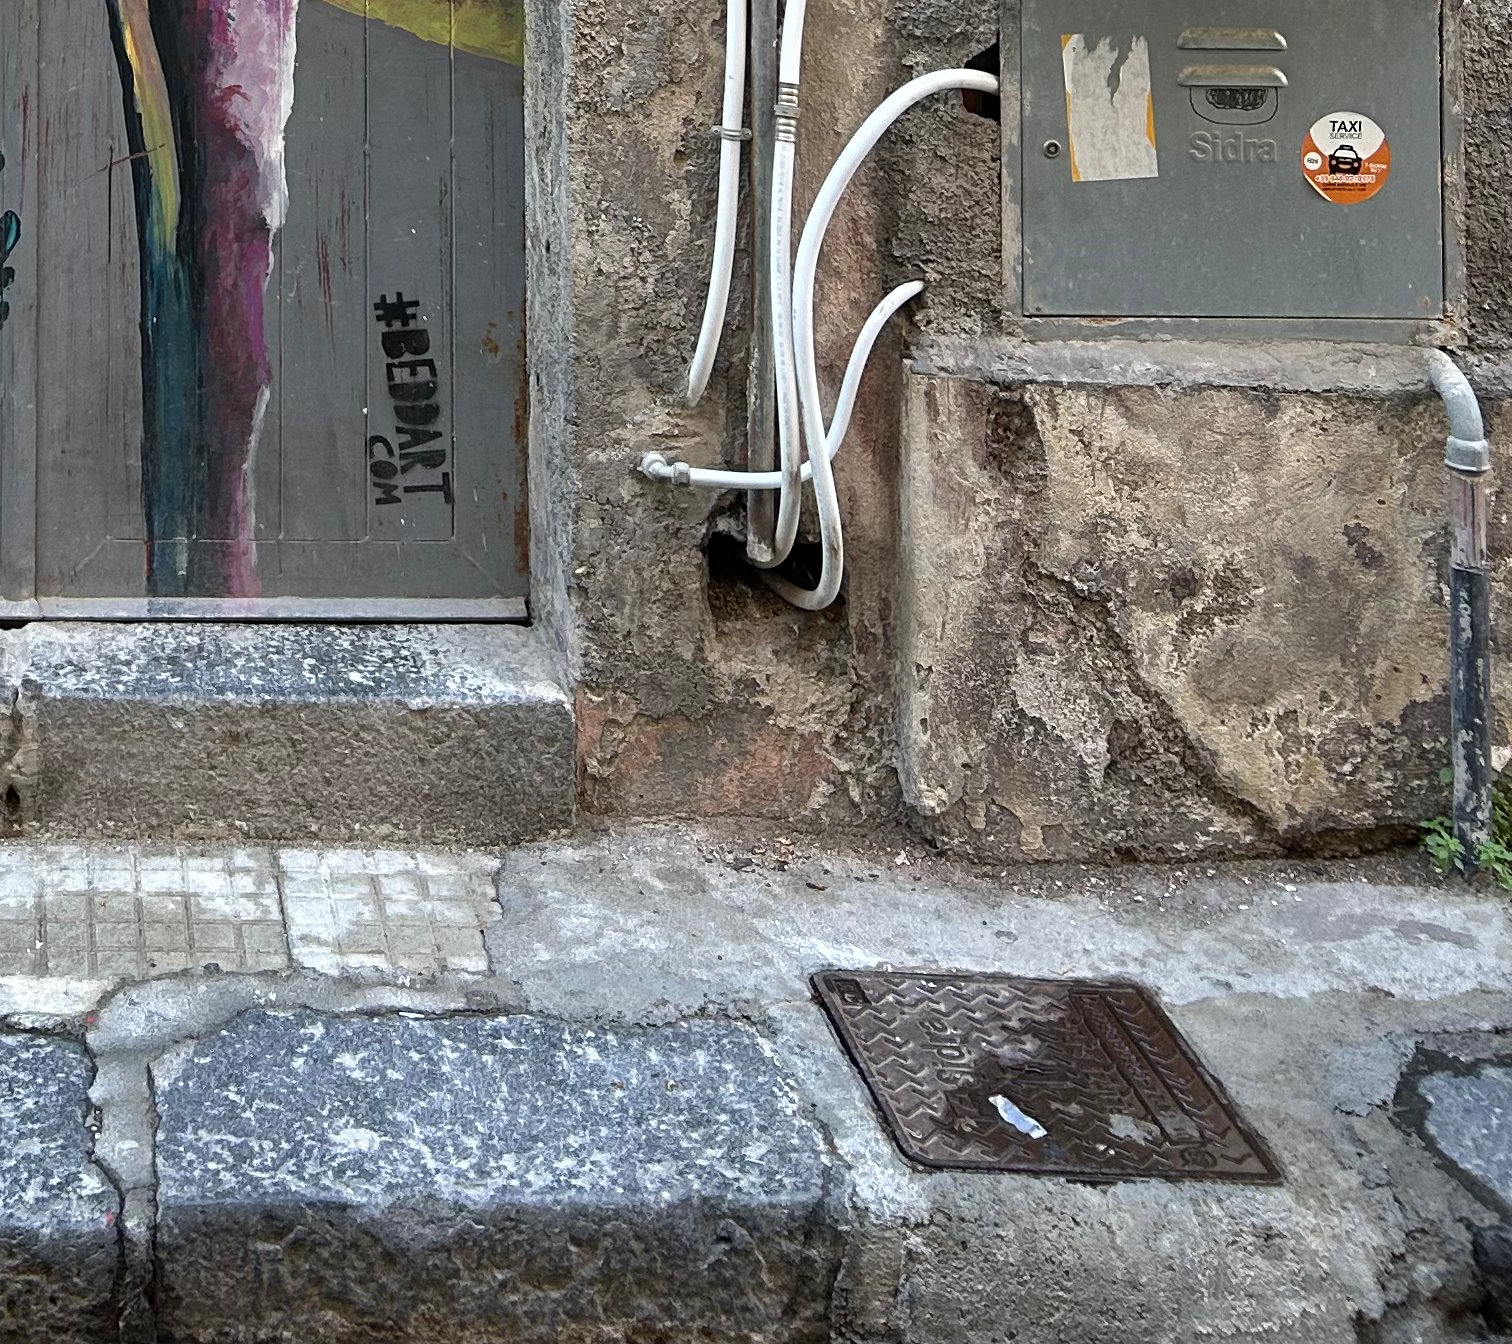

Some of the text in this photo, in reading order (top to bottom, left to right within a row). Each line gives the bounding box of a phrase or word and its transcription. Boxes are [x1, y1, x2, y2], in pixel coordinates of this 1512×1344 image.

[1189, 131, 1278, 163] Sidra
[1329, 120, 1362, 133] TAXI
[1329, 132, 1363, 140] SERVICE
[373, 291, 452, 505] #BEDDART
[368, 434, 402, 506] COM
[918, 1018, 977, 1088] Sidra
